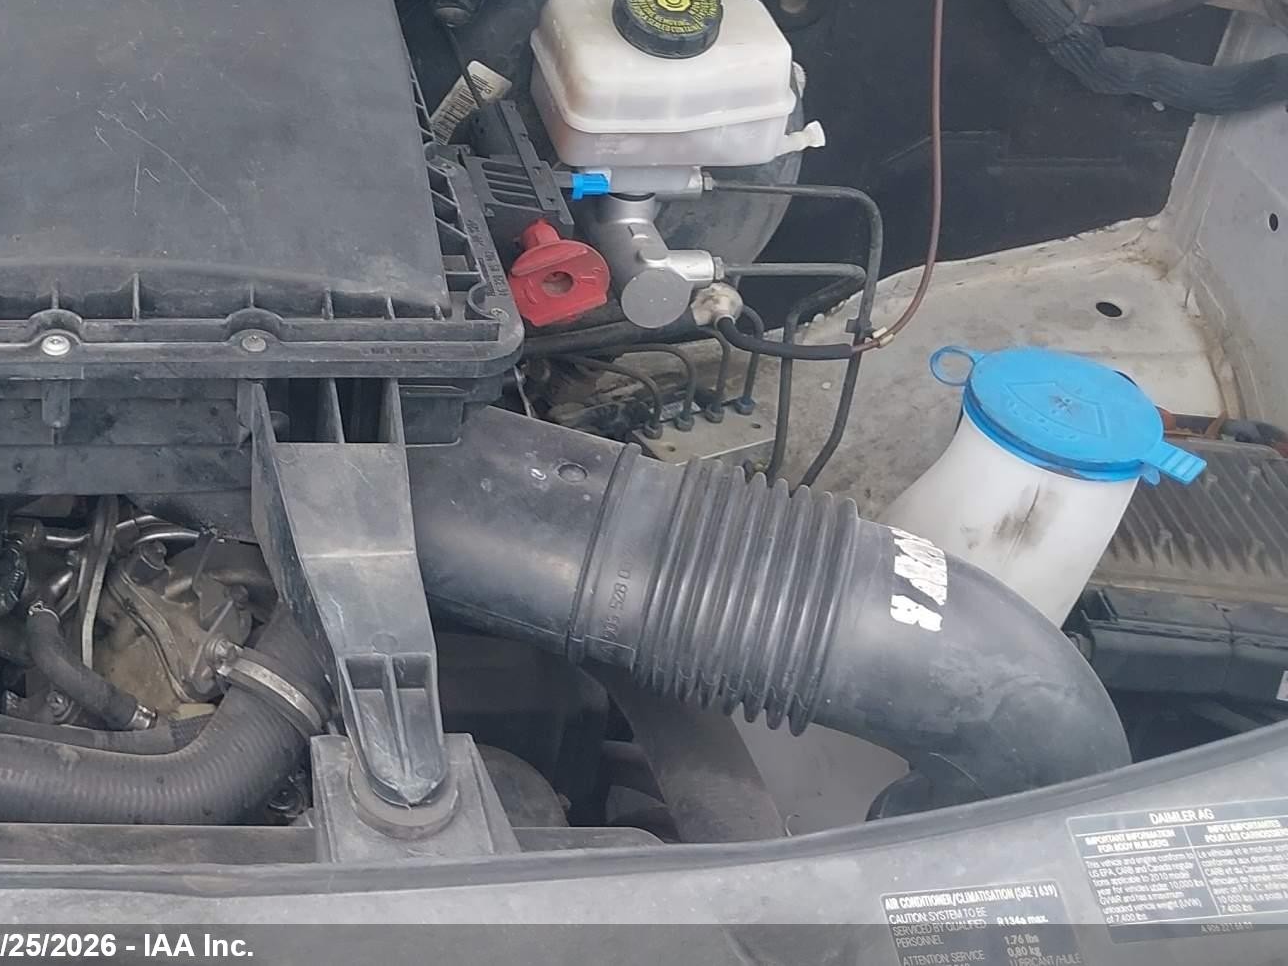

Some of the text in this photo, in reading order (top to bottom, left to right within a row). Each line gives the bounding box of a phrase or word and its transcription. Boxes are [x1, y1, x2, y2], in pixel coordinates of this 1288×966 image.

[1149, 808, 1214, 824] DAIMLER AG
[885, 898, 899, 911] AIR
[928, 908, 962, 922] SYSTEM
[962, 908, 976, 918] TO
[976, 906, 988, 917] BE
[892, 919, 987, 936] SERVICED BY QUALIFIED
[896, 934, 944, 948] PERSONNEL
[950, 950, 985, 963] SERVICE
